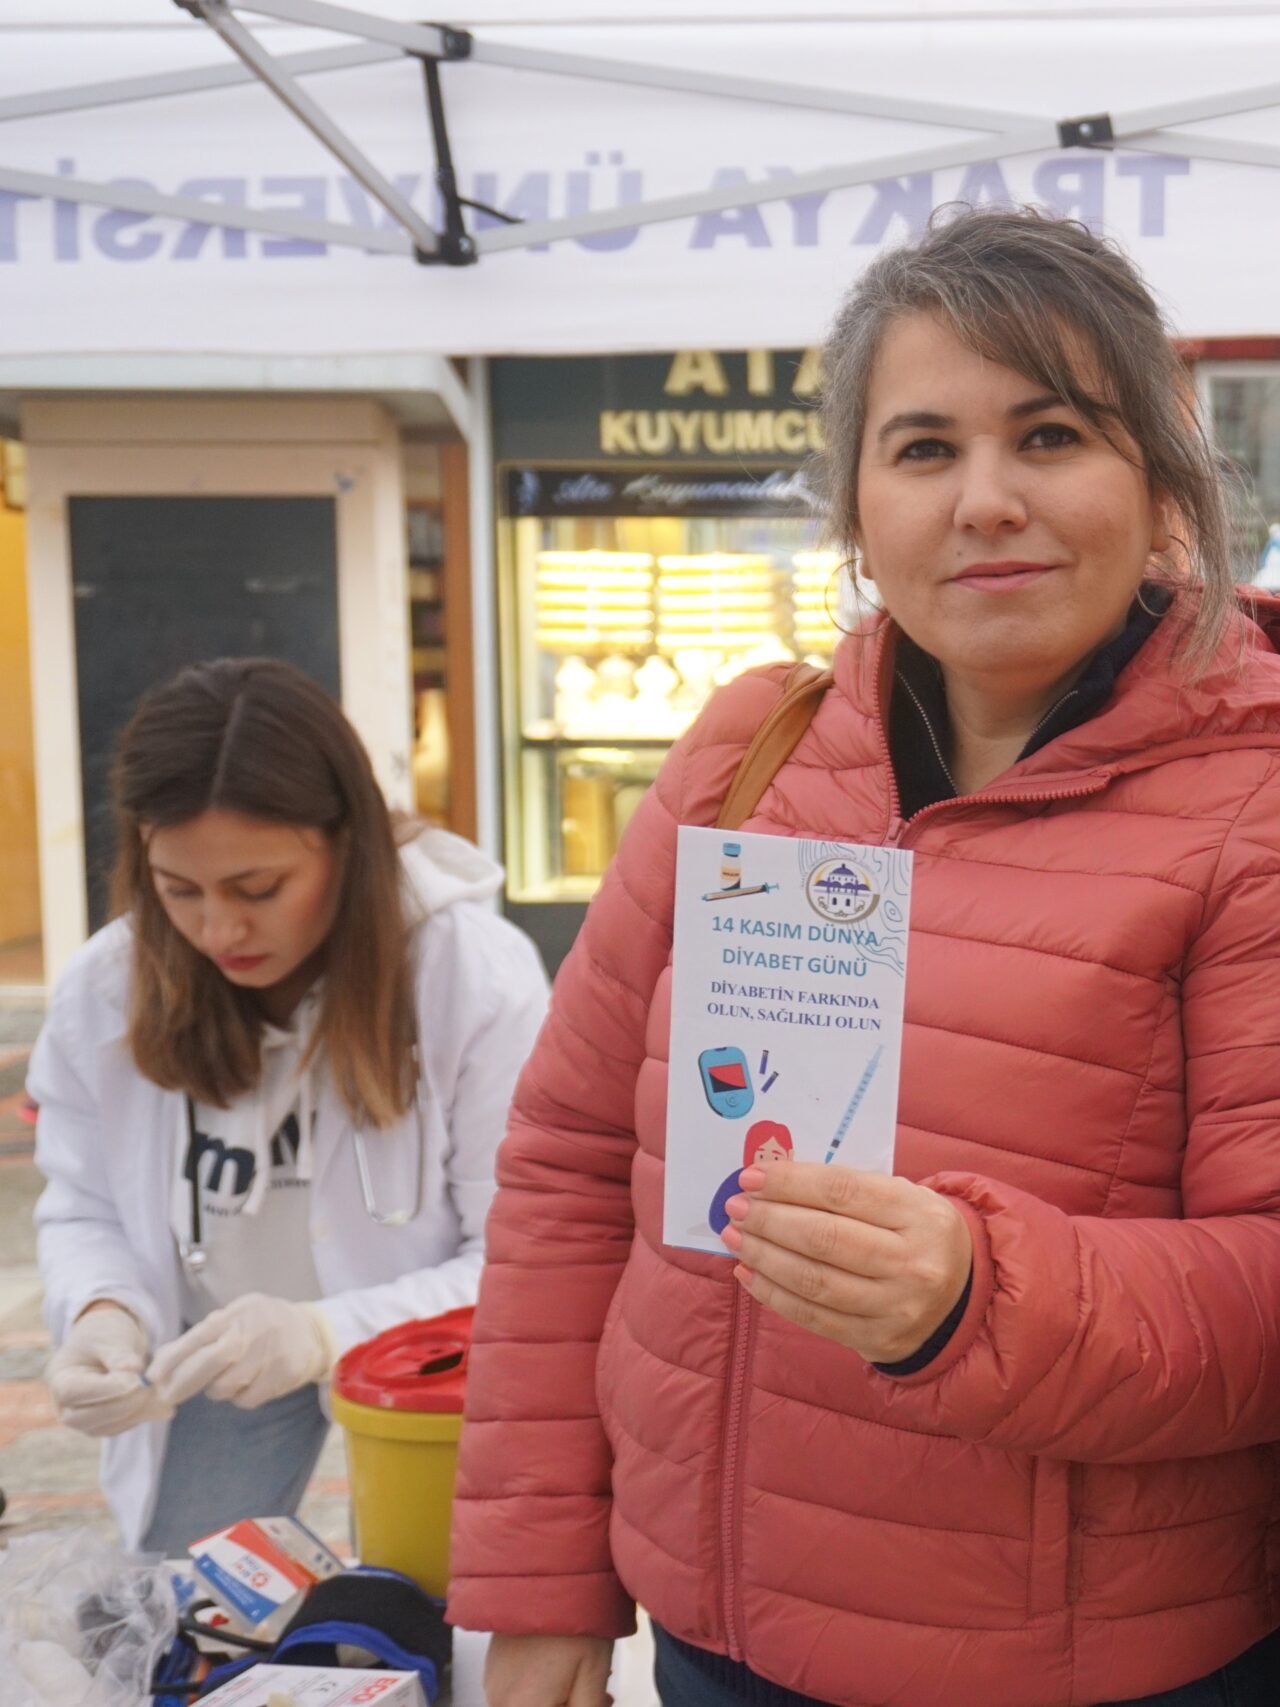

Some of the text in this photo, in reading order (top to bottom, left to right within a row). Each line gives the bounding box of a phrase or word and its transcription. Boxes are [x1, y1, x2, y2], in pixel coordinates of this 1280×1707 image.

[712, 915, 880, 946] 14 KASIM DÜNYA
[722, 946, 868, 978] DİYABET GÜNÜ
[710, 979, 880, 1010] DİYABETİN FARKINDA
[706, 1001, 882, 1031] OLUN, SAĞLIKLI OLUN
